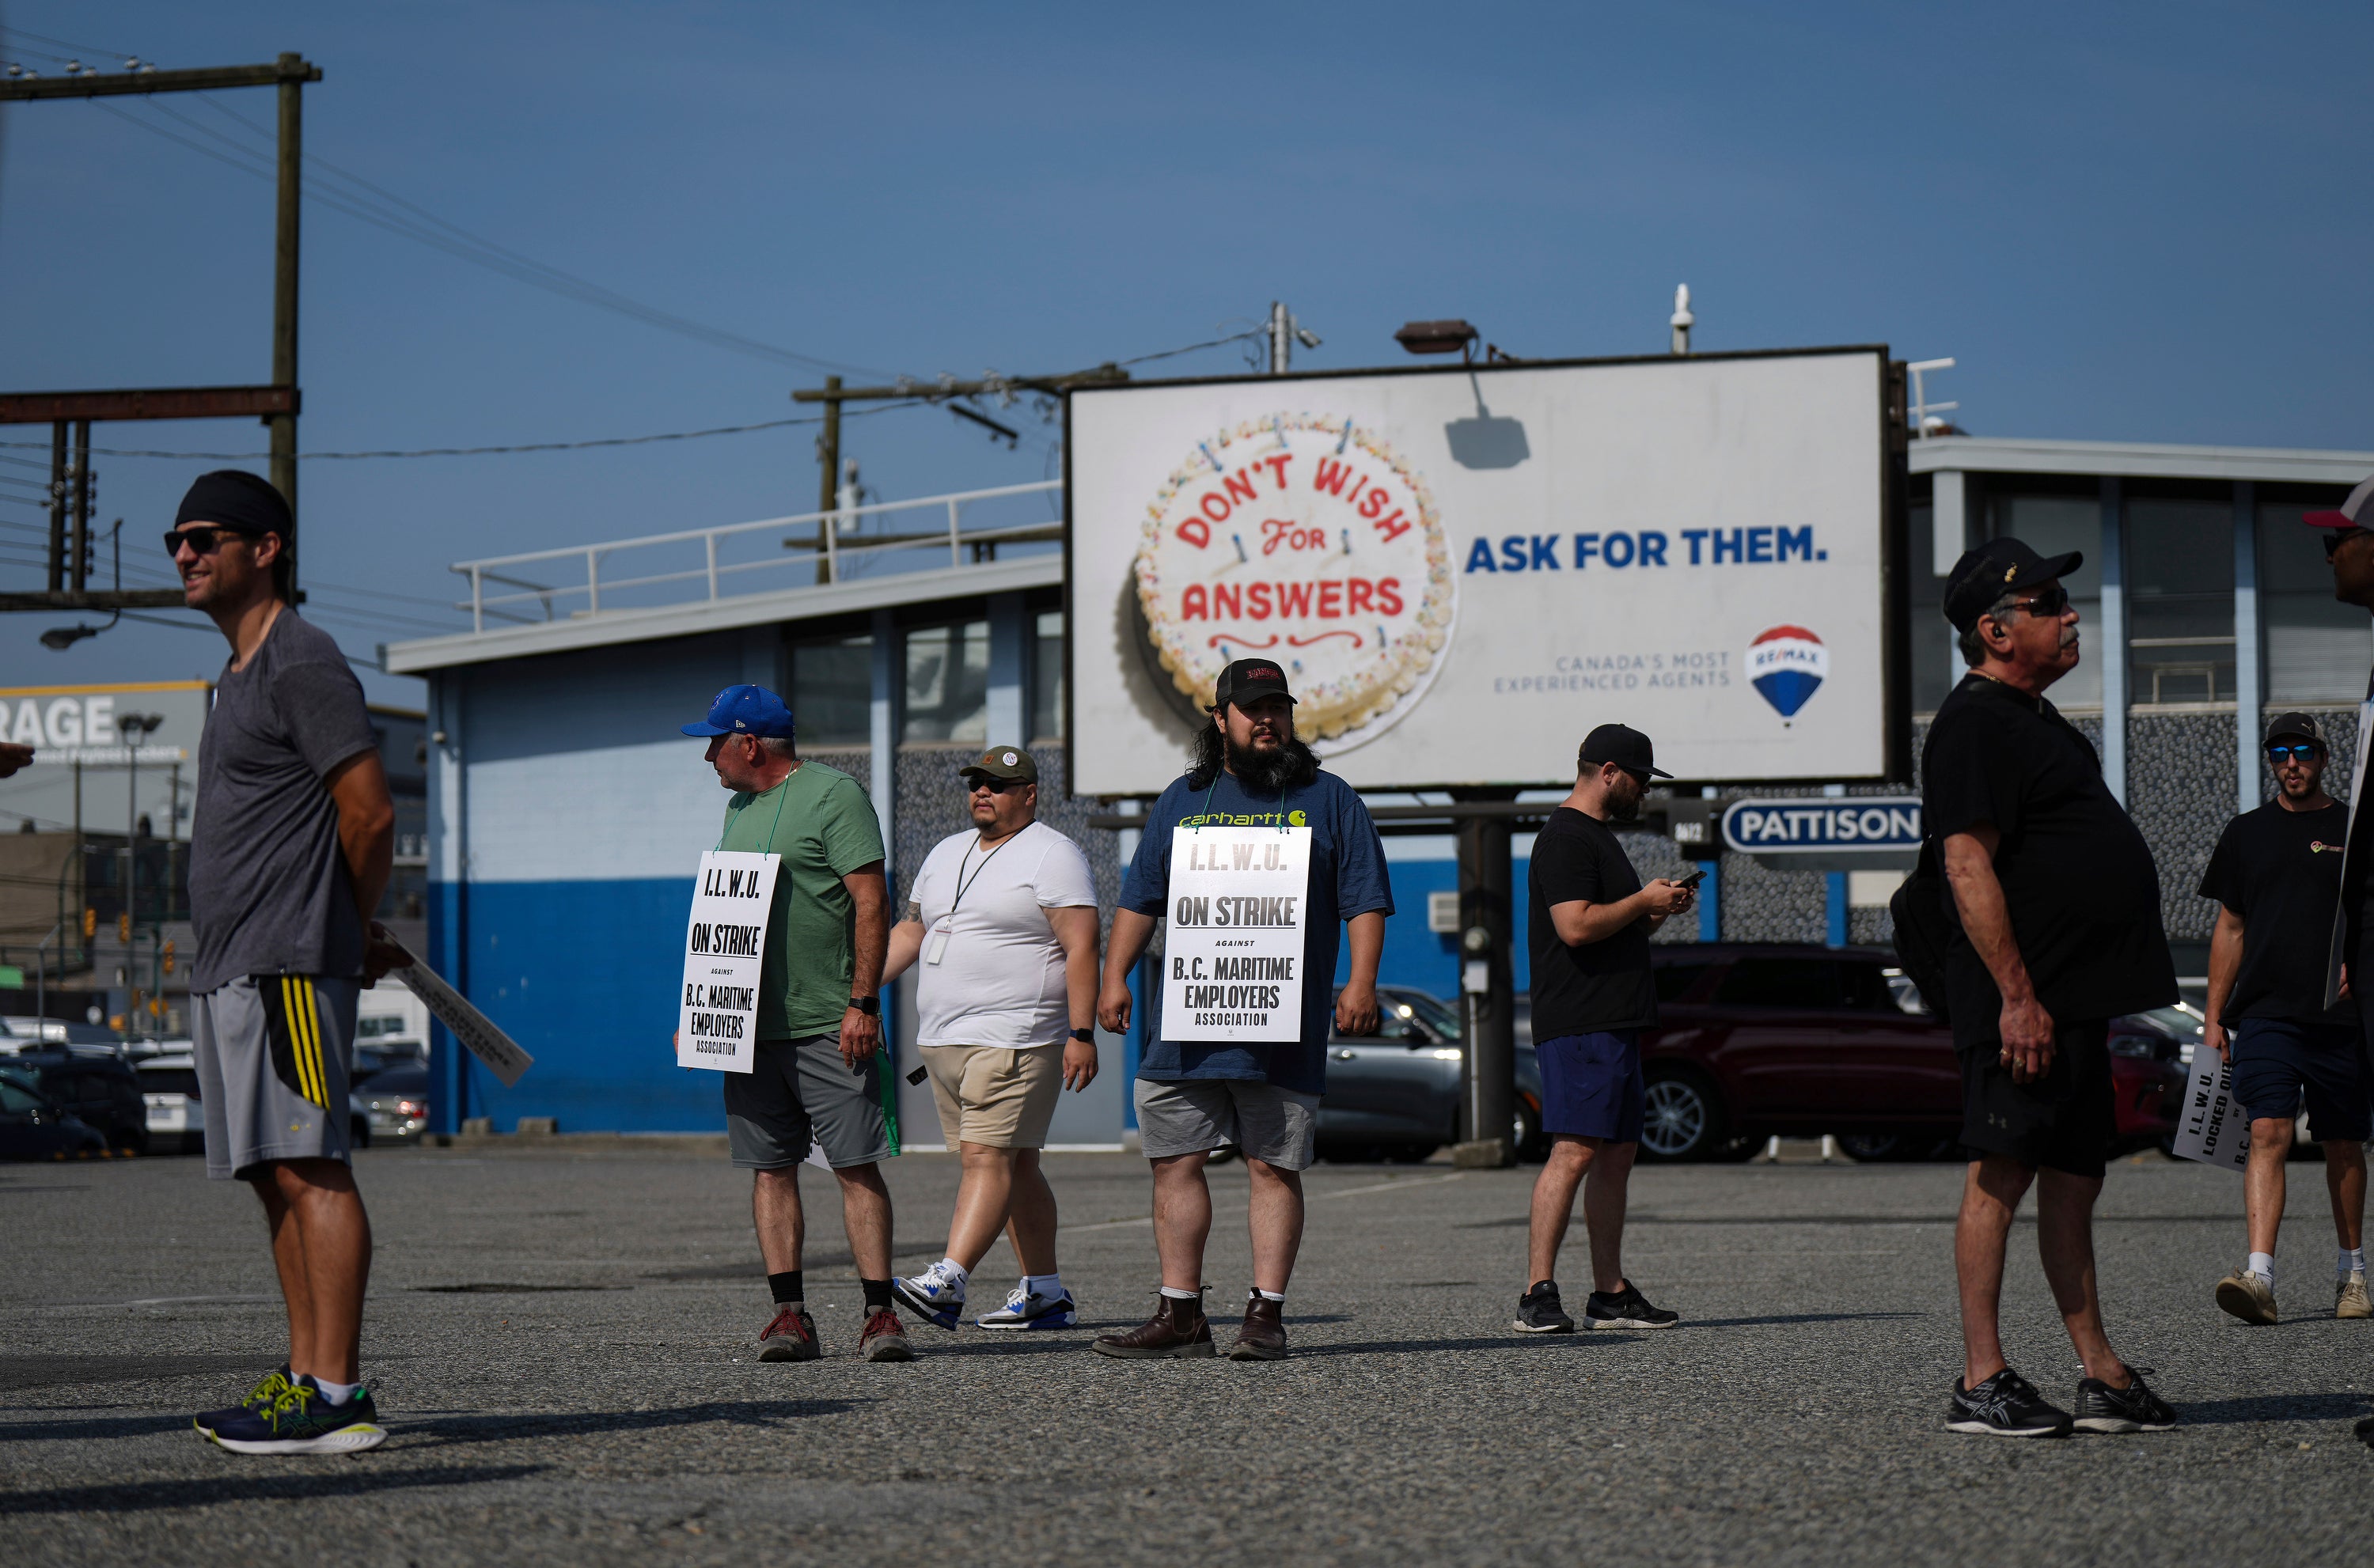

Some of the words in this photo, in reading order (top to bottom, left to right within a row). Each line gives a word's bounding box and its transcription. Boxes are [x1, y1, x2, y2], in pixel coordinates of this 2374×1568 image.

[1175, 453, 1292, 549] DON'T
[1314, 456, 1410, 543] WISH
[1465, 533, 1560, 573] ASK
[1573, 529, 1668, 569] FOR
[1681, 525, 1827, 566] THEM.
[1181, 577, 1403, 620] ANSWERS
[1555, 653, 1663, 672] CANADA'S
[1672, 651, 1730, 669] MOST
[1756, 647, 1818, 665] RE/MAX
[1494, 673, 1638, 693] EXPERIENCED
[1647, 670, 1731, 688] AGENTS
[1178, 812, 1284, 828] carhartt
[1741, 809, 1920, 840] PATTISON
[1189, 843, 1287, 871] I.L.W.U.
[704, 869, 760, 899] I.L.W.U.
[1176, 896, 1209, 926] ON
[1215, 896, 1298, 926] STRIKE
[692, 922, 711, 953] ON
[713, 924, 760, 956] STRIKE
[1173, 956, 1208, 980] B.C.
[1214, 956, 1295, 980] MARITIME
[685, 983, 705, 1008] B.C.
[708, 985, 754, 1012] MARITIME
[1184, 985, 1280, 1009] EMPLOYERS
[691, 1012, 744, 1040] EMPLOYERS
[1194, 1013, 1268, 1026] ASSOCIATION
[696, 1040, 736, 1056] ASSOCIATION
[2189, 1072, 2214, 1135] I.L.W.U.
[2232, 1108, 2240, 1118] BY
[2203, 1095, 2228, 1157] LOCKED
